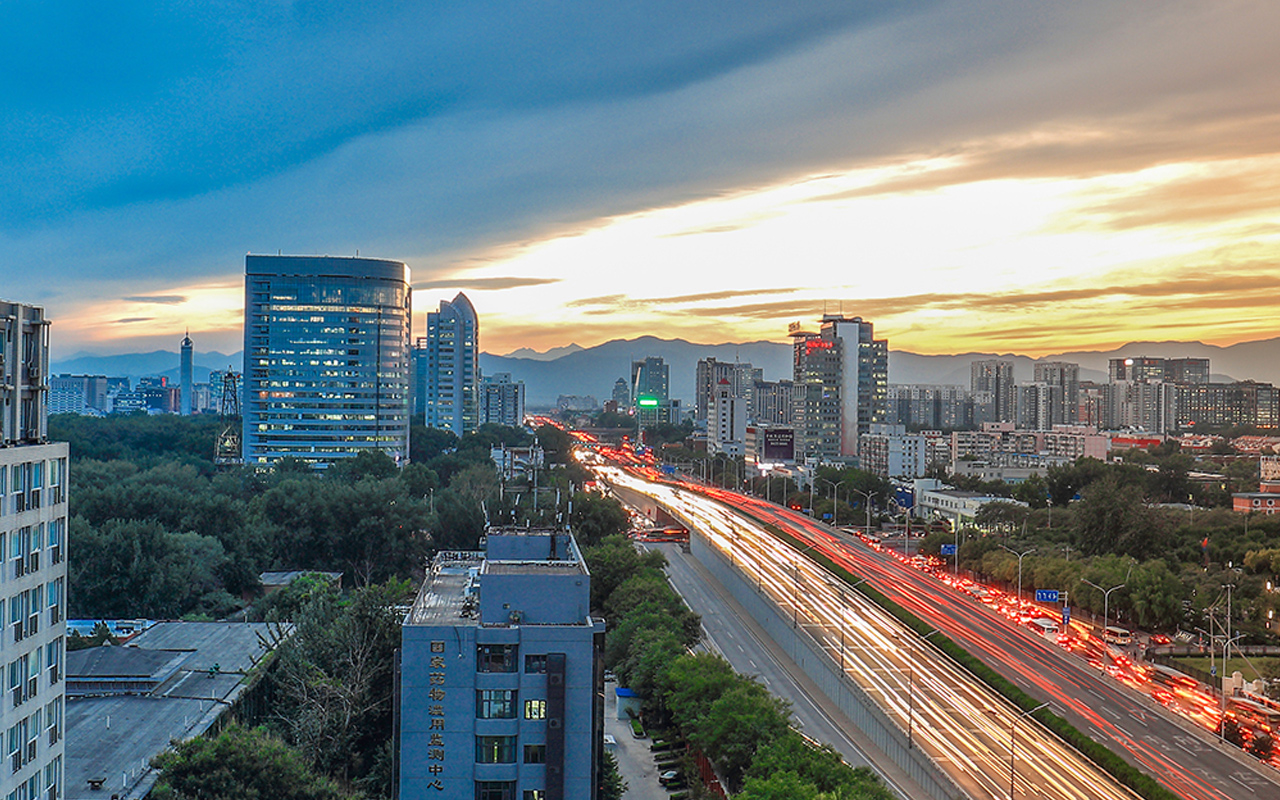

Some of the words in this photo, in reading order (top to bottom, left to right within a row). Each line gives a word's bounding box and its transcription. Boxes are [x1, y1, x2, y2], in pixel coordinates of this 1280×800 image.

[426, 640, 446, 791] 国家药物滥用监测中心
